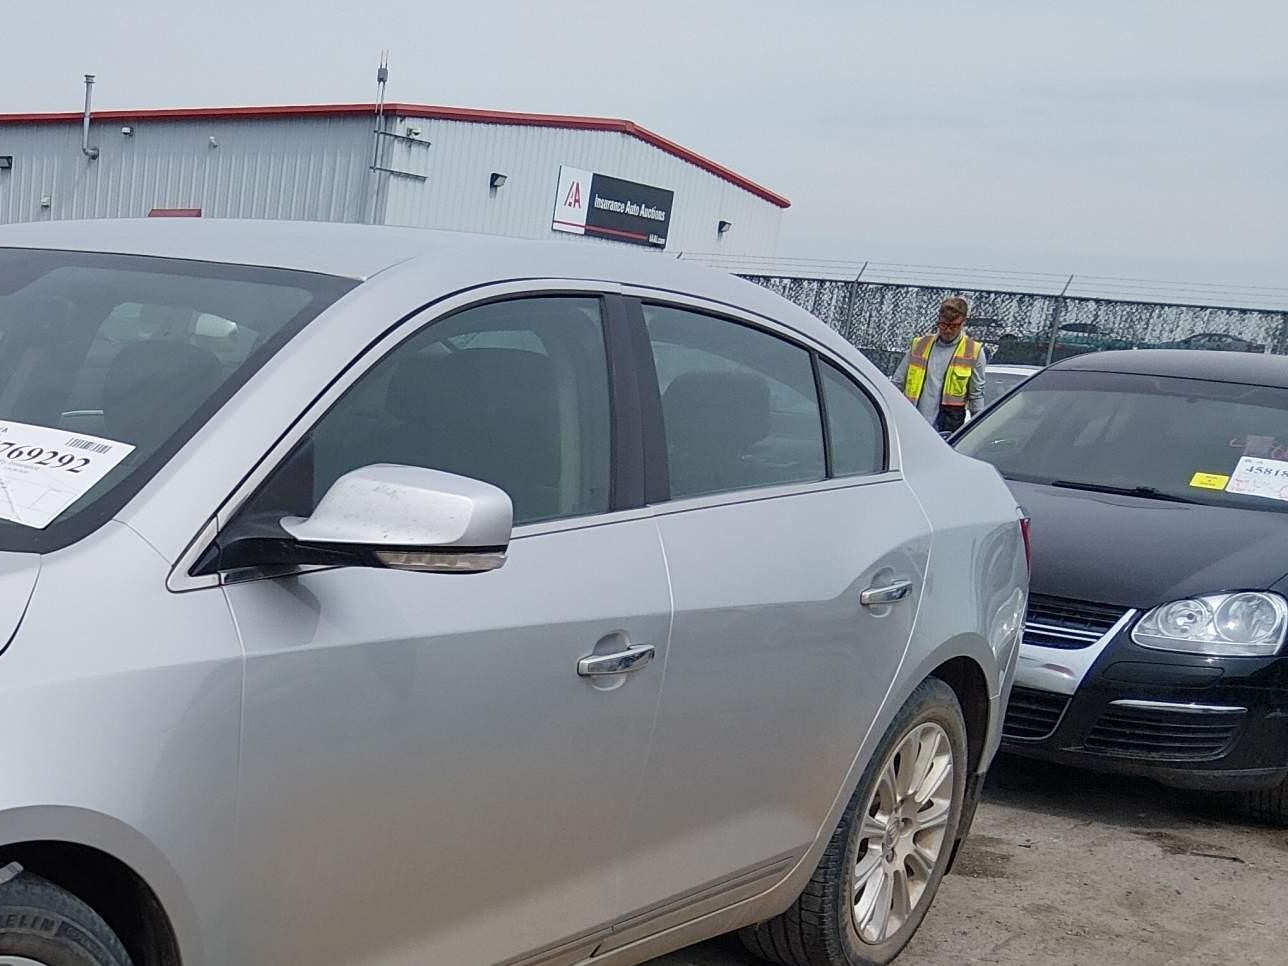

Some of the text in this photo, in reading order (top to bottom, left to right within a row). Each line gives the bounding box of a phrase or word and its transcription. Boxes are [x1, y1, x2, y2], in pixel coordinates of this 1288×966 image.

[594, 193, 666, 222] Insurance Auto Auctions
[1246, 466, 1288, 478] 45818
